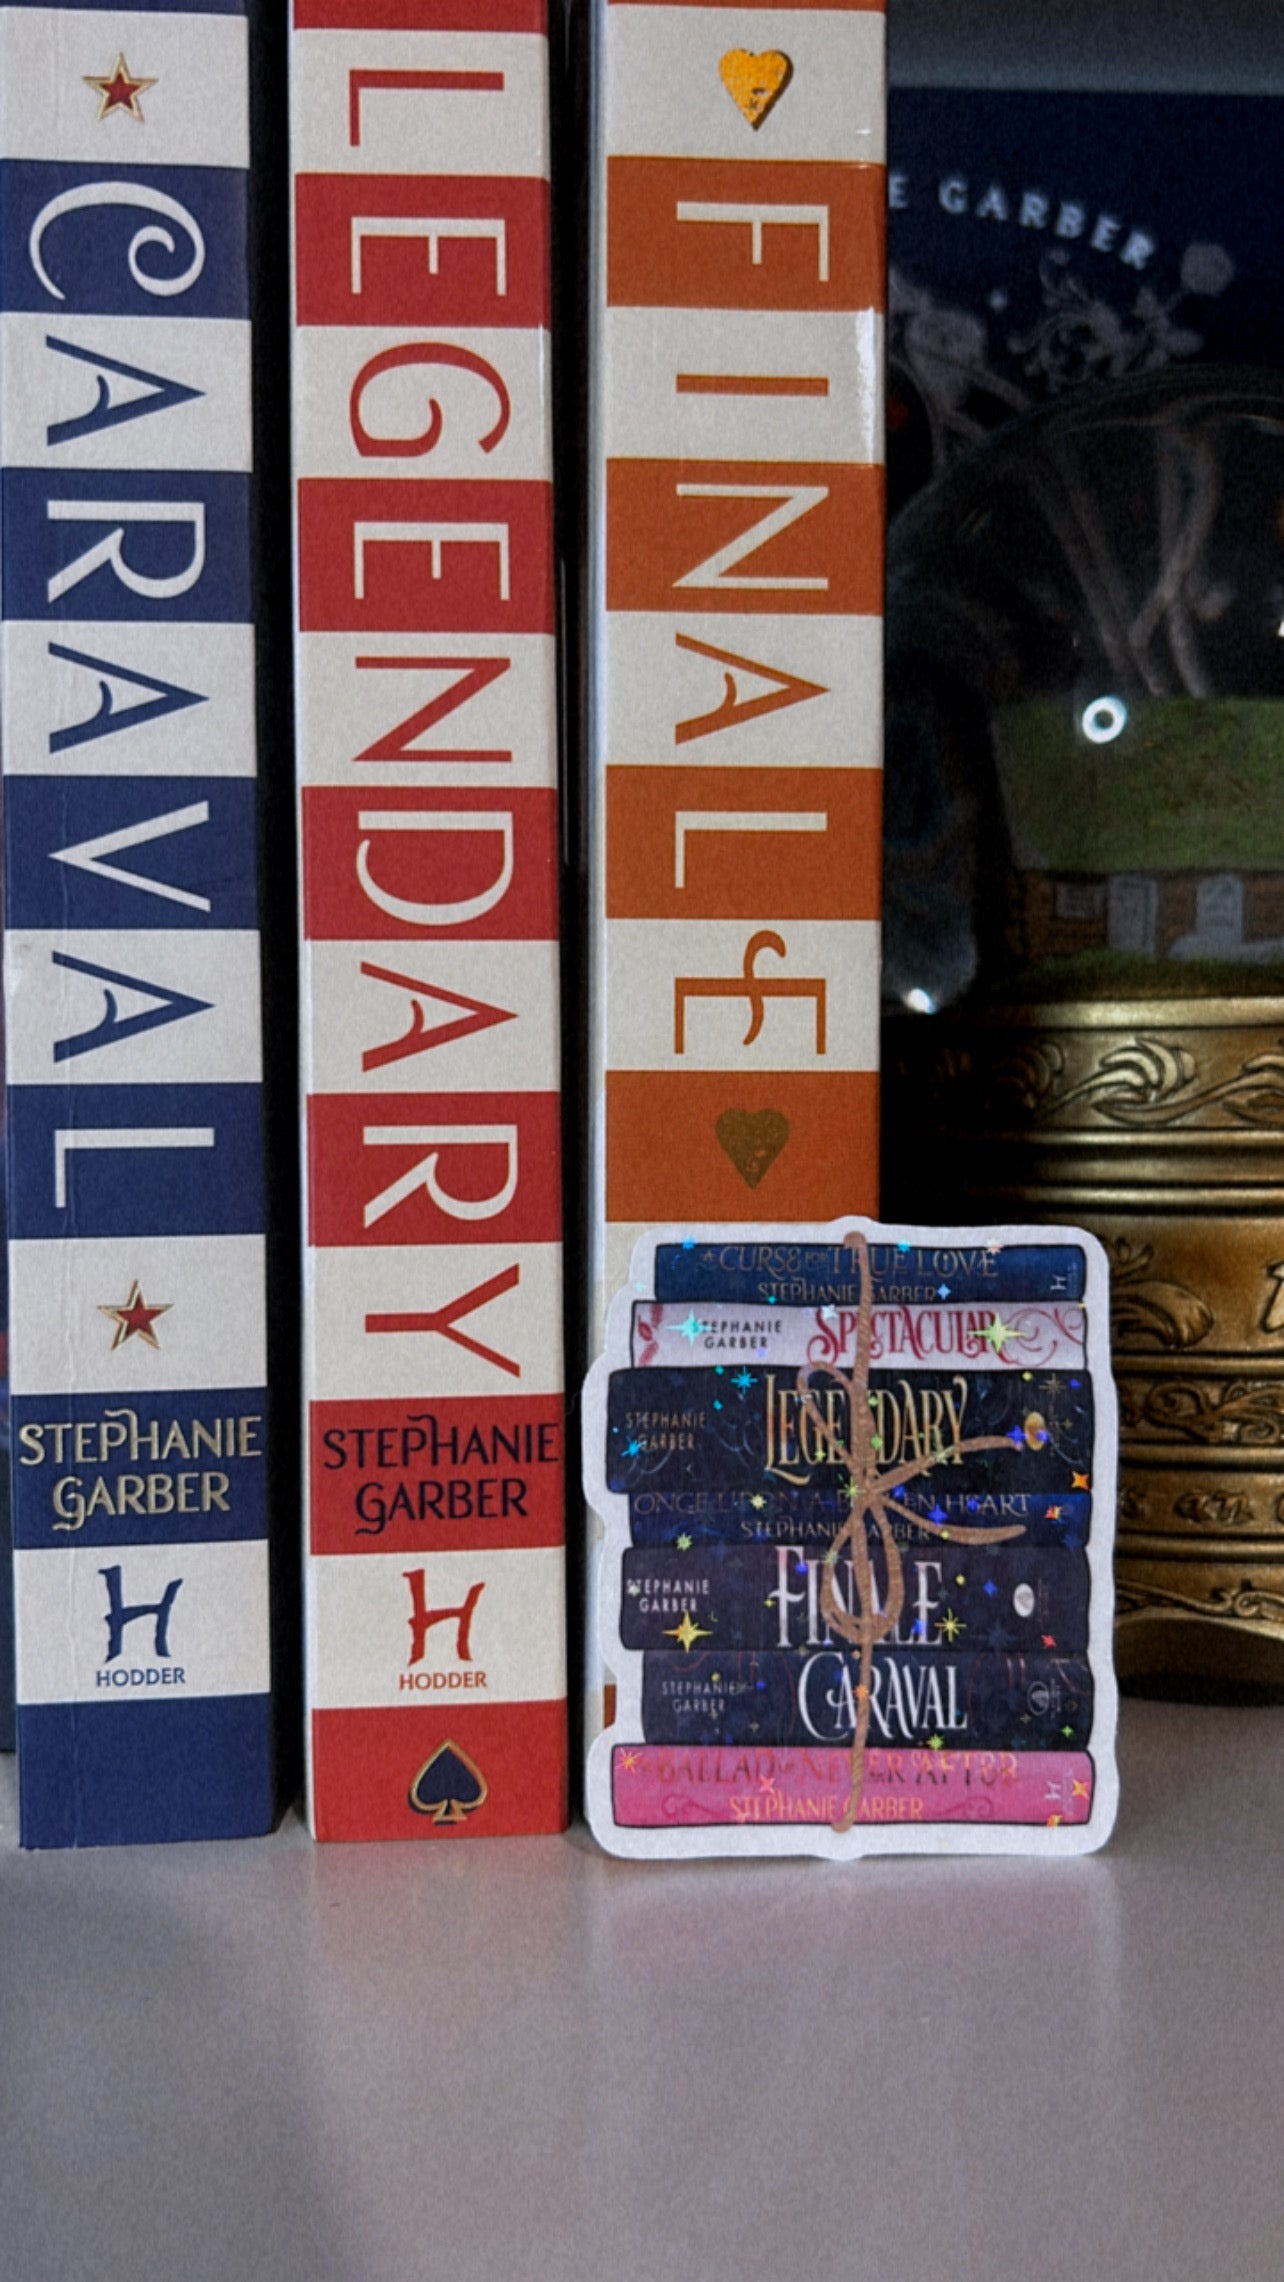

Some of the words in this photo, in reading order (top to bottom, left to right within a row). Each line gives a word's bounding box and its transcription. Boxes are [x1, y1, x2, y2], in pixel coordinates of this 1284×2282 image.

[938, 178, 1156, 271] GARBER
[671, 200, 831, 1055] FINALE
[28, 180, 218, 1209] CARAVAL
[348, 68, 521, 1378] LEGENDARY
[757, 1277, 857, 1304] STEPHANIE
[868, 1284, 937, 1303] ARBER
[917, 1248, 1000, 1279] LOVE
[703, 1336, 768, 1350] GARBER
[807, 1304, 1024, 1368] SPCTACULAR
[18, 1408, 263, 1466] STEPHANIE
[322, 1413, 560, 1470] STEPHANIE
[625, 1411, 706, 1429] STEPHANIE
[637, 1432, 696, 1451] GARBER
[764, 1373, 968, 1486] LEGEDARY
[52, 1470, 231, 1531] GARBER
[354, 1476, 529, 1536] GARBER
[740, 1516, 842, 1538] STEPHANI
[98, 1564, 184, 1664] H
[401, 1567, 486, 1667] H
[639, 1597, 698, 1613] GARBER
[96, 1667, 186, 1688] HODDER
[399, 1671, 488, 1691] HODDER
[661, 1681, 736, 1696] STEPHANIE
[672, 1698, 725, 1713] GARBER
[797, 1651, 968, 1741] CARAVAL
[729, 1792, 837, 1821] STEPHANIE
